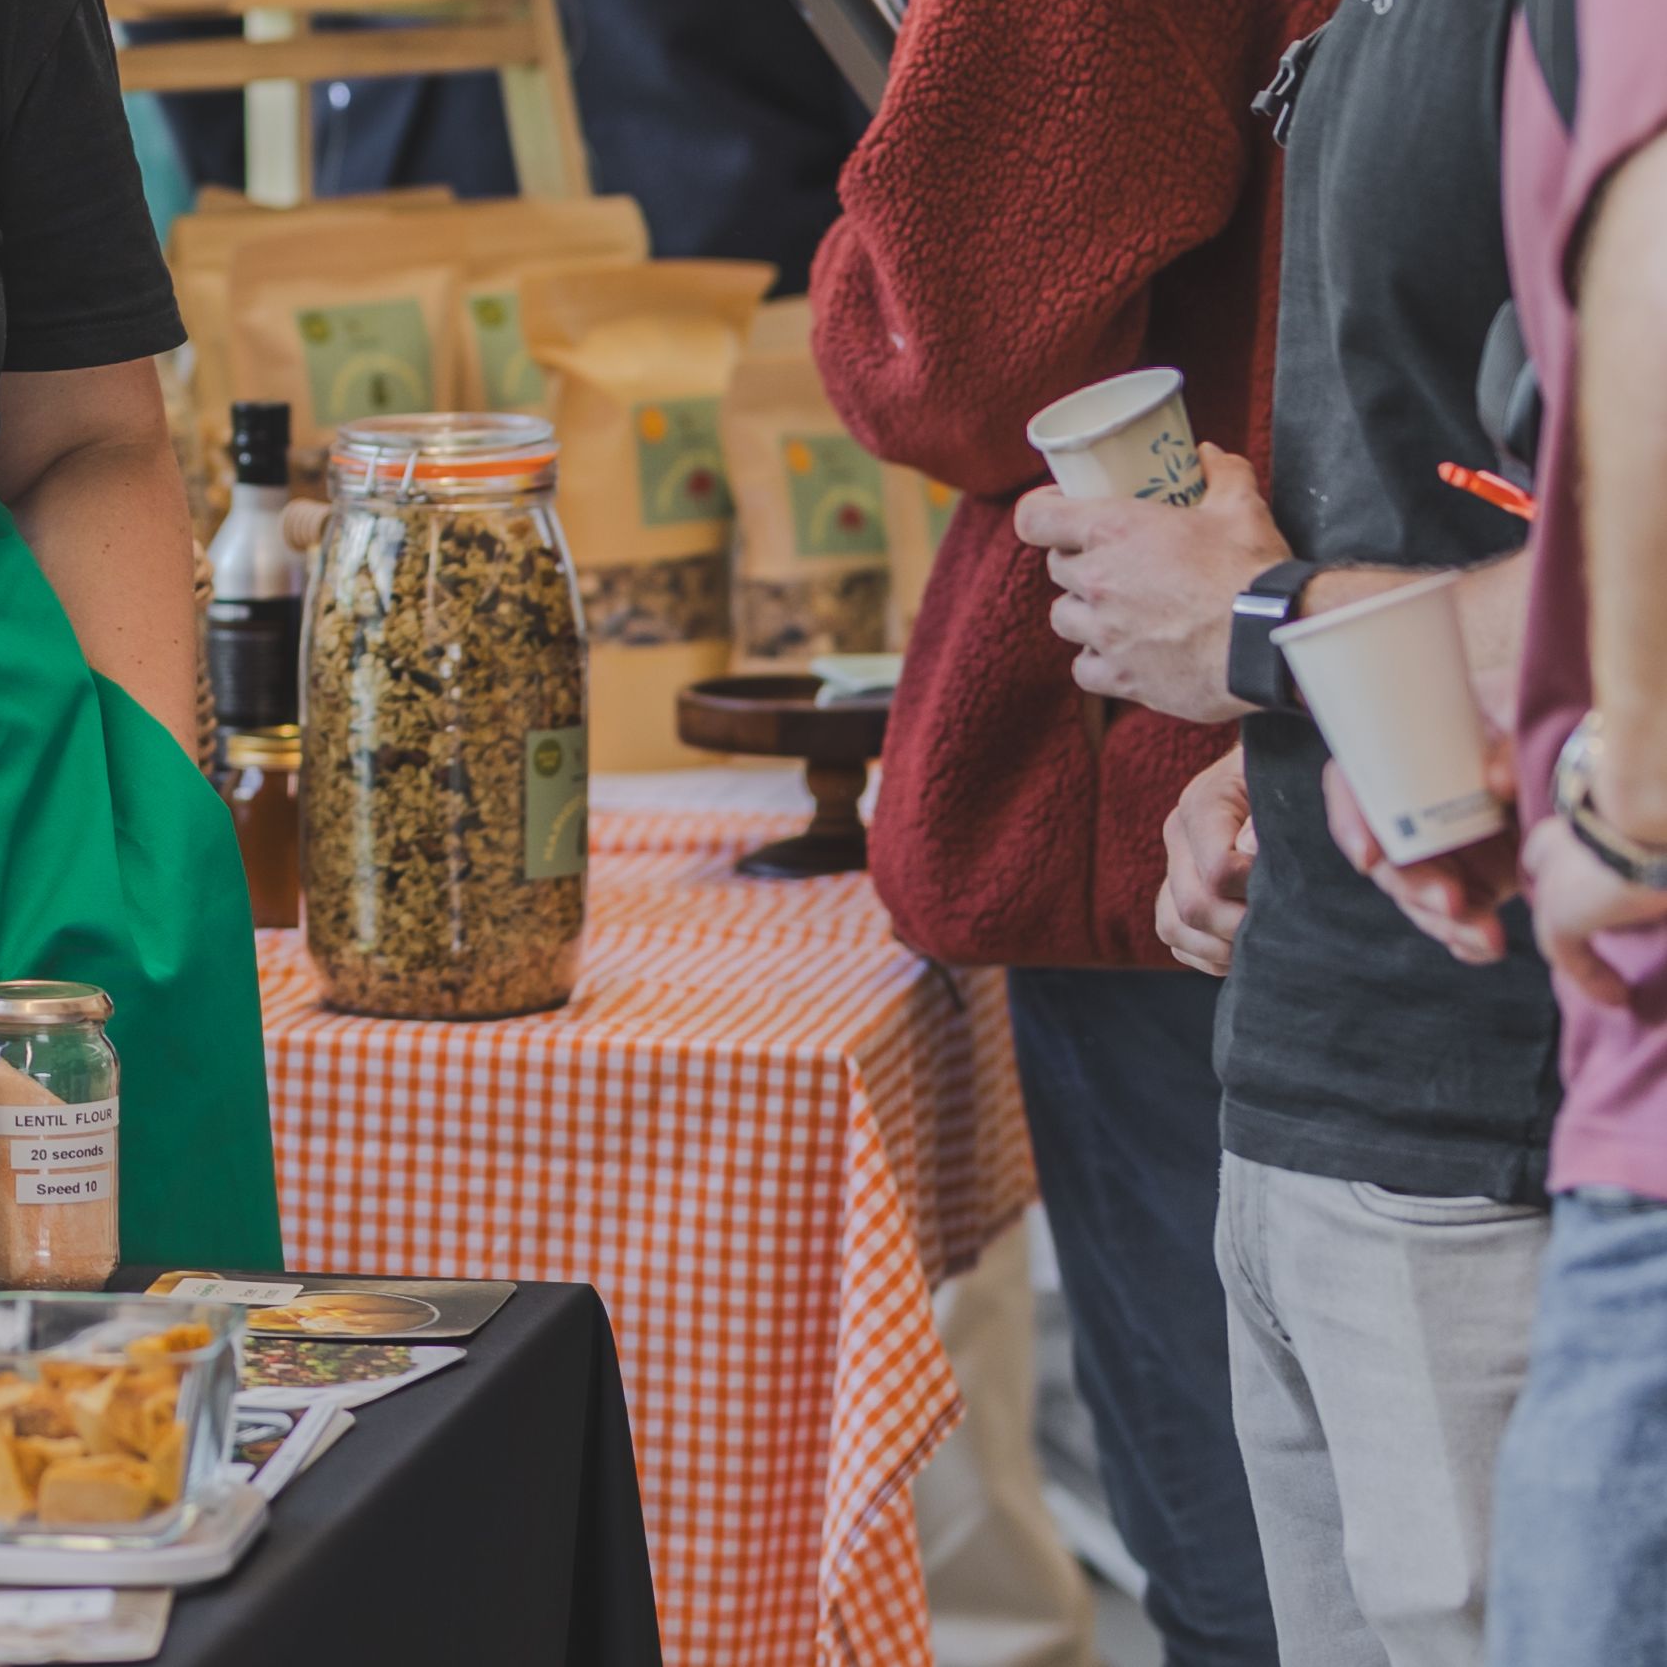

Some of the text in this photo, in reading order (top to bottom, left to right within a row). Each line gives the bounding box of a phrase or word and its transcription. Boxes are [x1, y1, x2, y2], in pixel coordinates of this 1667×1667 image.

[15, 1108, 113, 1128] LENTIL FLOUR
[31, 1145, 104, 1161] 20 seconds
[36, 1180, 98, 1196] Speed 10
